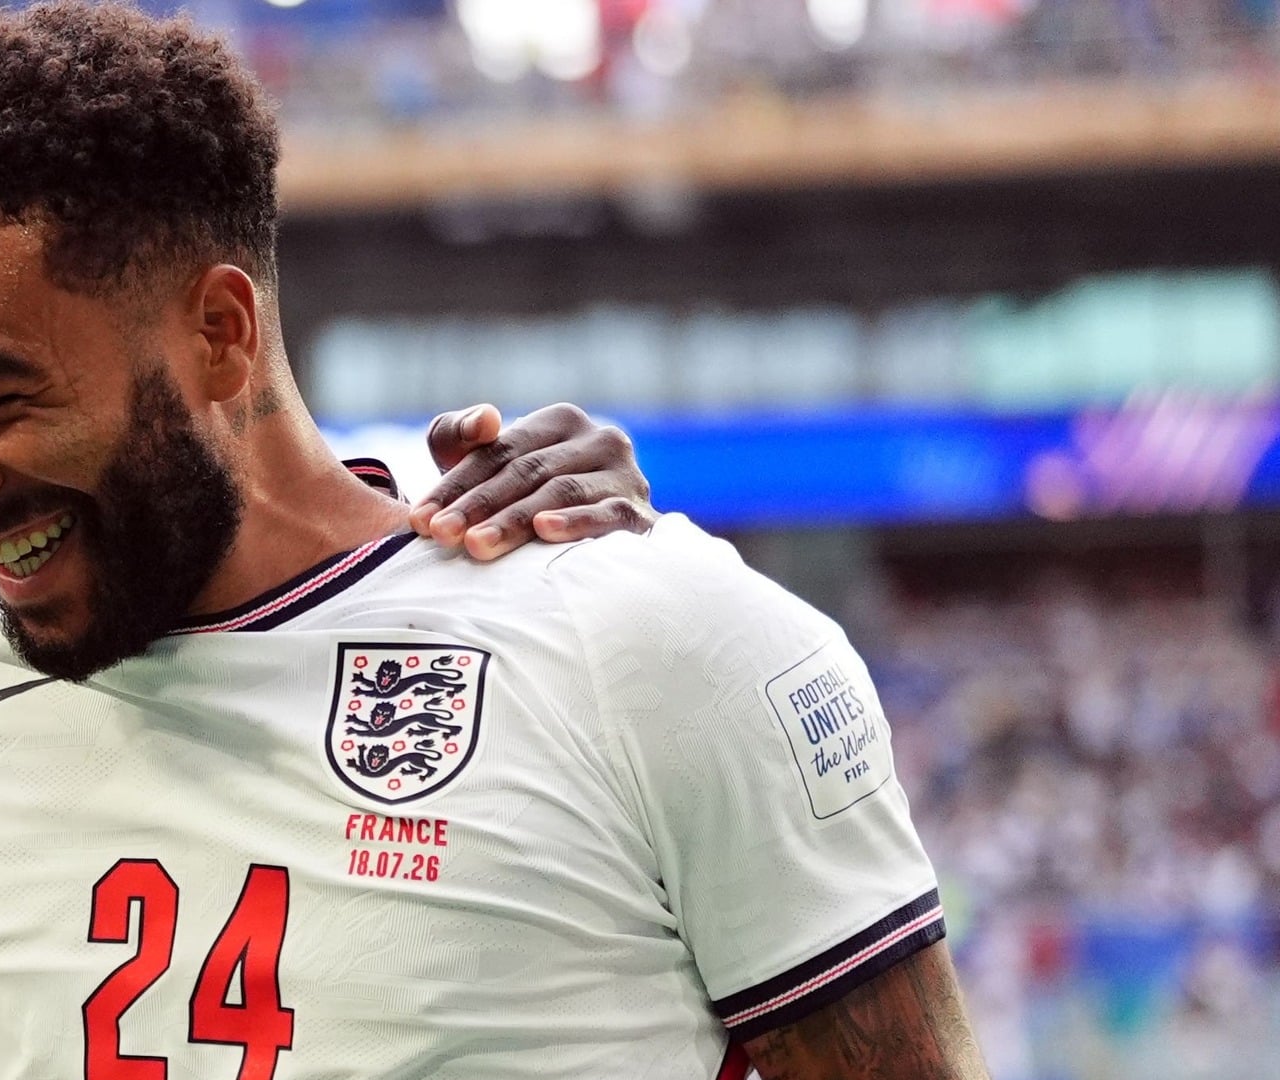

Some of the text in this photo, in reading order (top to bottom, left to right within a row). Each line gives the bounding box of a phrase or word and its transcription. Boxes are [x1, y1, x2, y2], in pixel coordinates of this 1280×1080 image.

[800, 686, 865, 745] UNITES
[810, 719, 879, 778] the World
[844, 760, 870, 783] FIFA
[345, 813, 448, 847] FRANCE
[348, 849, 440, 882] 18.07.26
